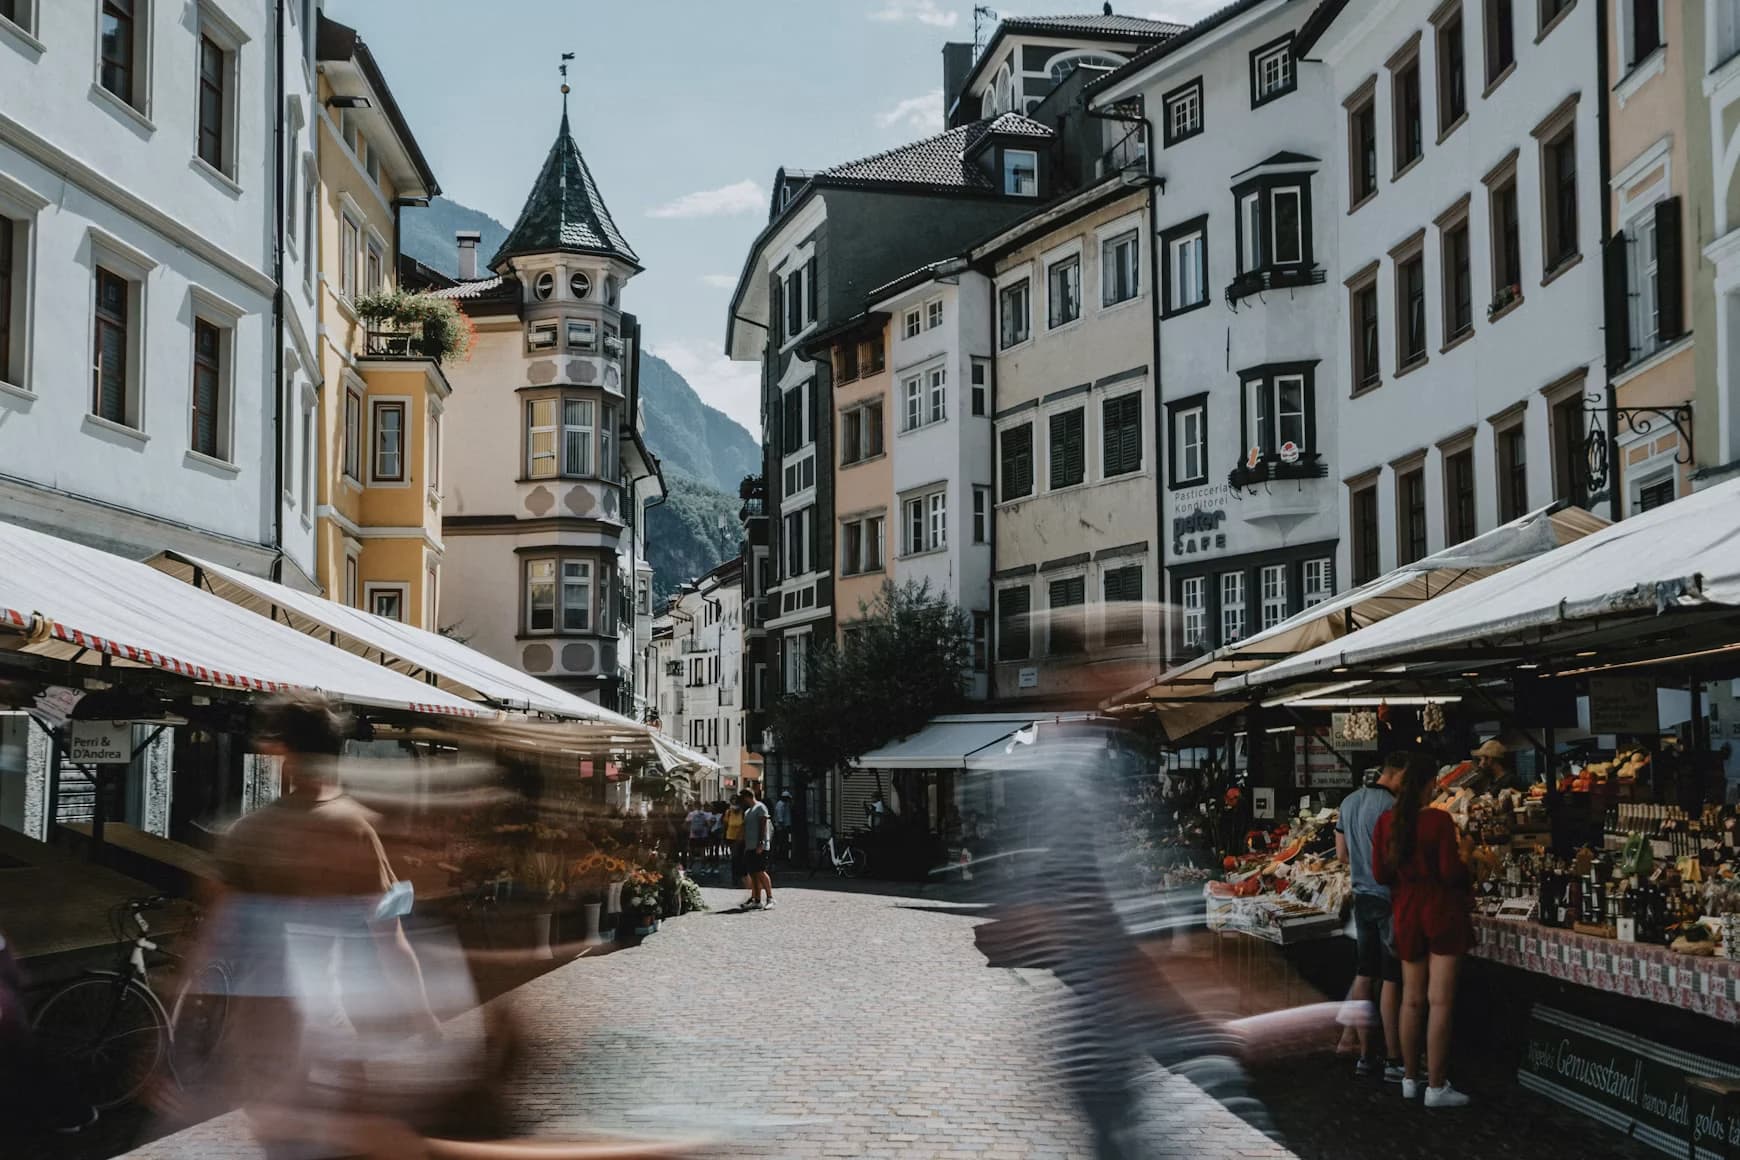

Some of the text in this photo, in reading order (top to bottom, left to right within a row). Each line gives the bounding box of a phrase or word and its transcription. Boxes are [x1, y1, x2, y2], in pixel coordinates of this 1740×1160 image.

[1174, 483, 1228, 501] Pasticceria
[1175, 496, 1228, 514] Konditorei
[1173, 509, 1227, 542] peter
[1173, 534, 1227, 556] CAFE
[74, 737, 111, 747] Perri &
[73, 749, 121, 759] D'Andrea
[1557, 1039, 1642, 1105] Genussstandl
[1668, 1091, 1689, 1125] dell
